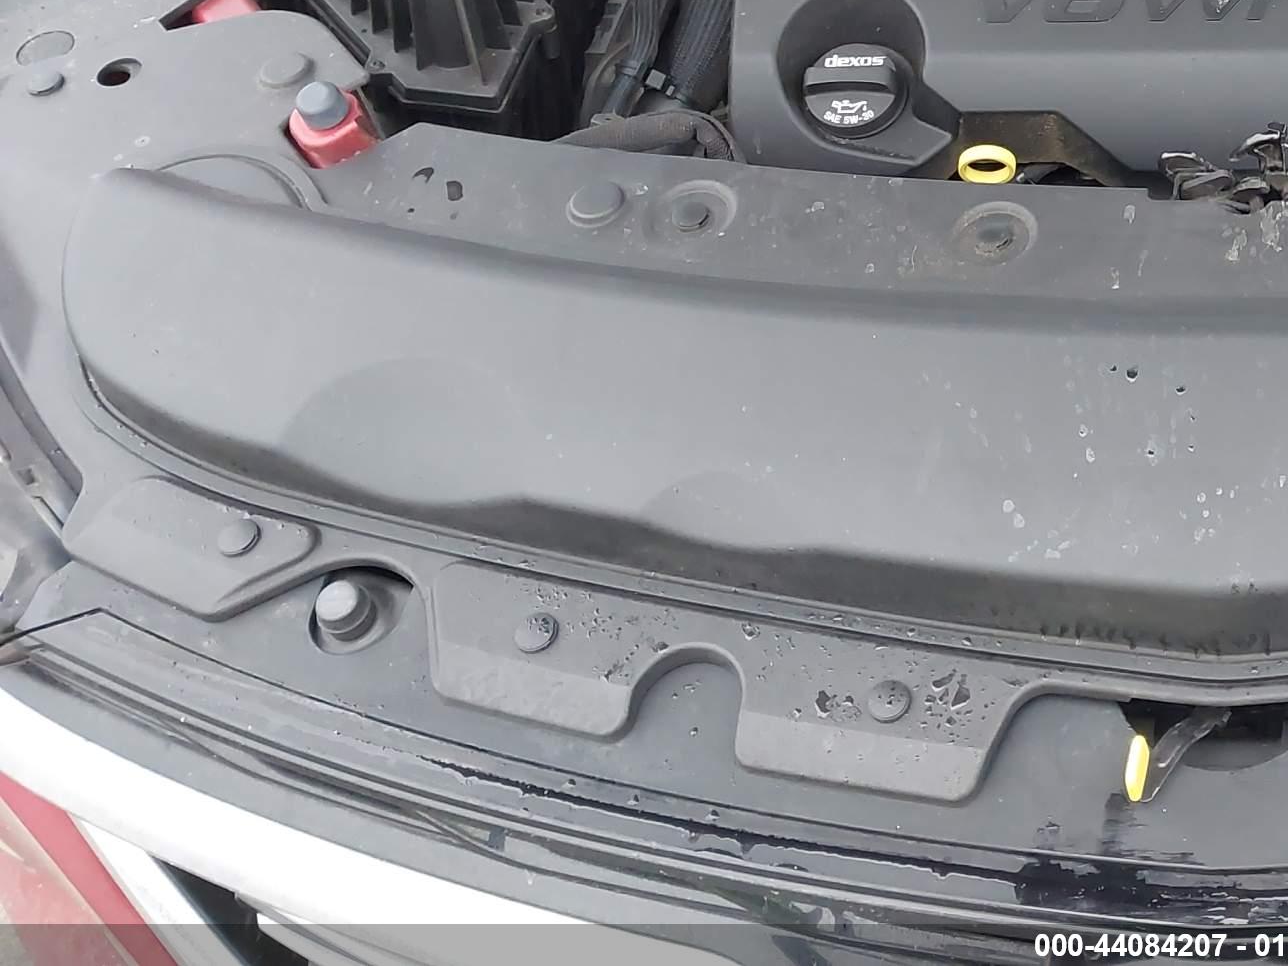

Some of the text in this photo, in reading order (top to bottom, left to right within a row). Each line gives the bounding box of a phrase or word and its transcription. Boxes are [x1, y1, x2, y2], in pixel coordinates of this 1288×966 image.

[824, 54, 888, 68] dexos
[823, 110, 875, 125] SAE 5W-30
